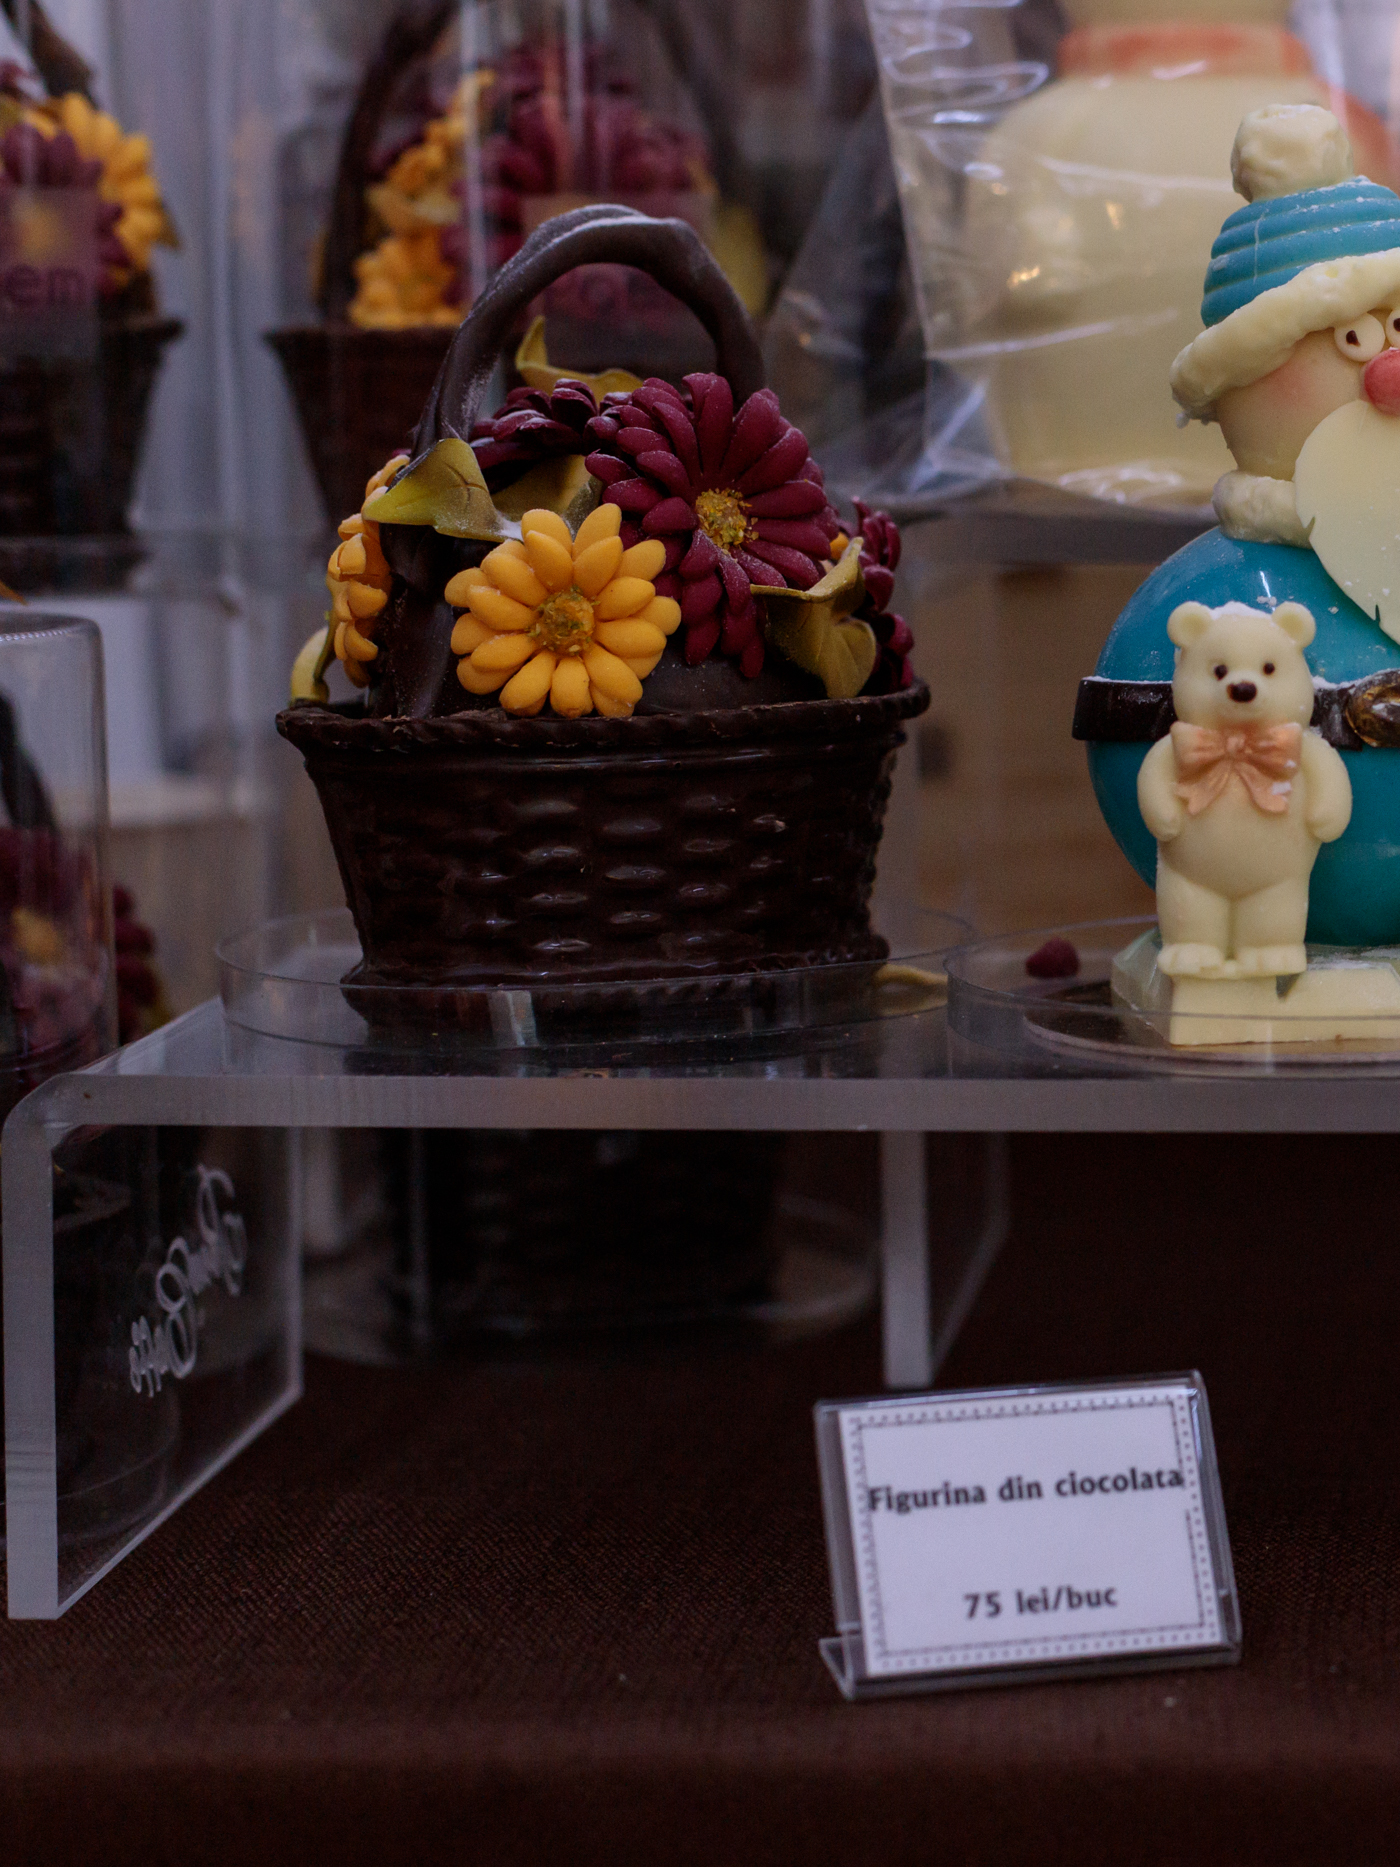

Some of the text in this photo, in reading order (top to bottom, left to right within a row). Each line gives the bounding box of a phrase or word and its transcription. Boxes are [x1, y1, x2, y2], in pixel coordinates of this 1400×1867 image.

[866, 1467, 1185, 1515] Figurina din ciocolata
[964, 1583, 1118, 1619] 75 lei/buc
